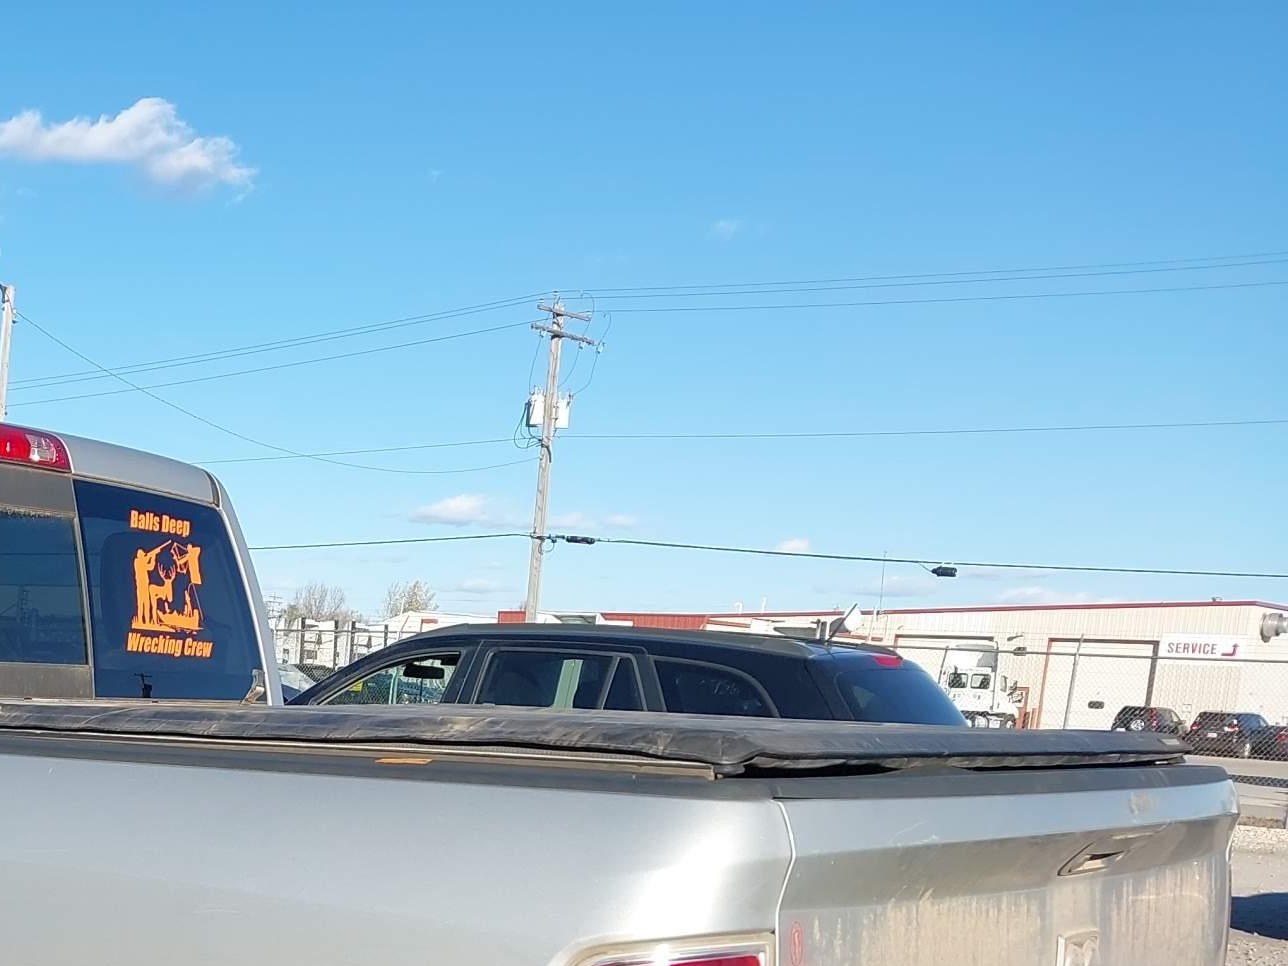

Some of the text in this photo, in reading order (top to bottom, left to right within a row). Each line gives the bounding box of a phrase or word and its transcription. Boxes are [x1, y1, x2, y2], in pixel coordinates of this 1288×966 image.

[129, 509, 191, 538] Balls Deep
[127, 632, 213, 658] Wrecking Crew
[1167, 642, 1218, 655] SERVICE
